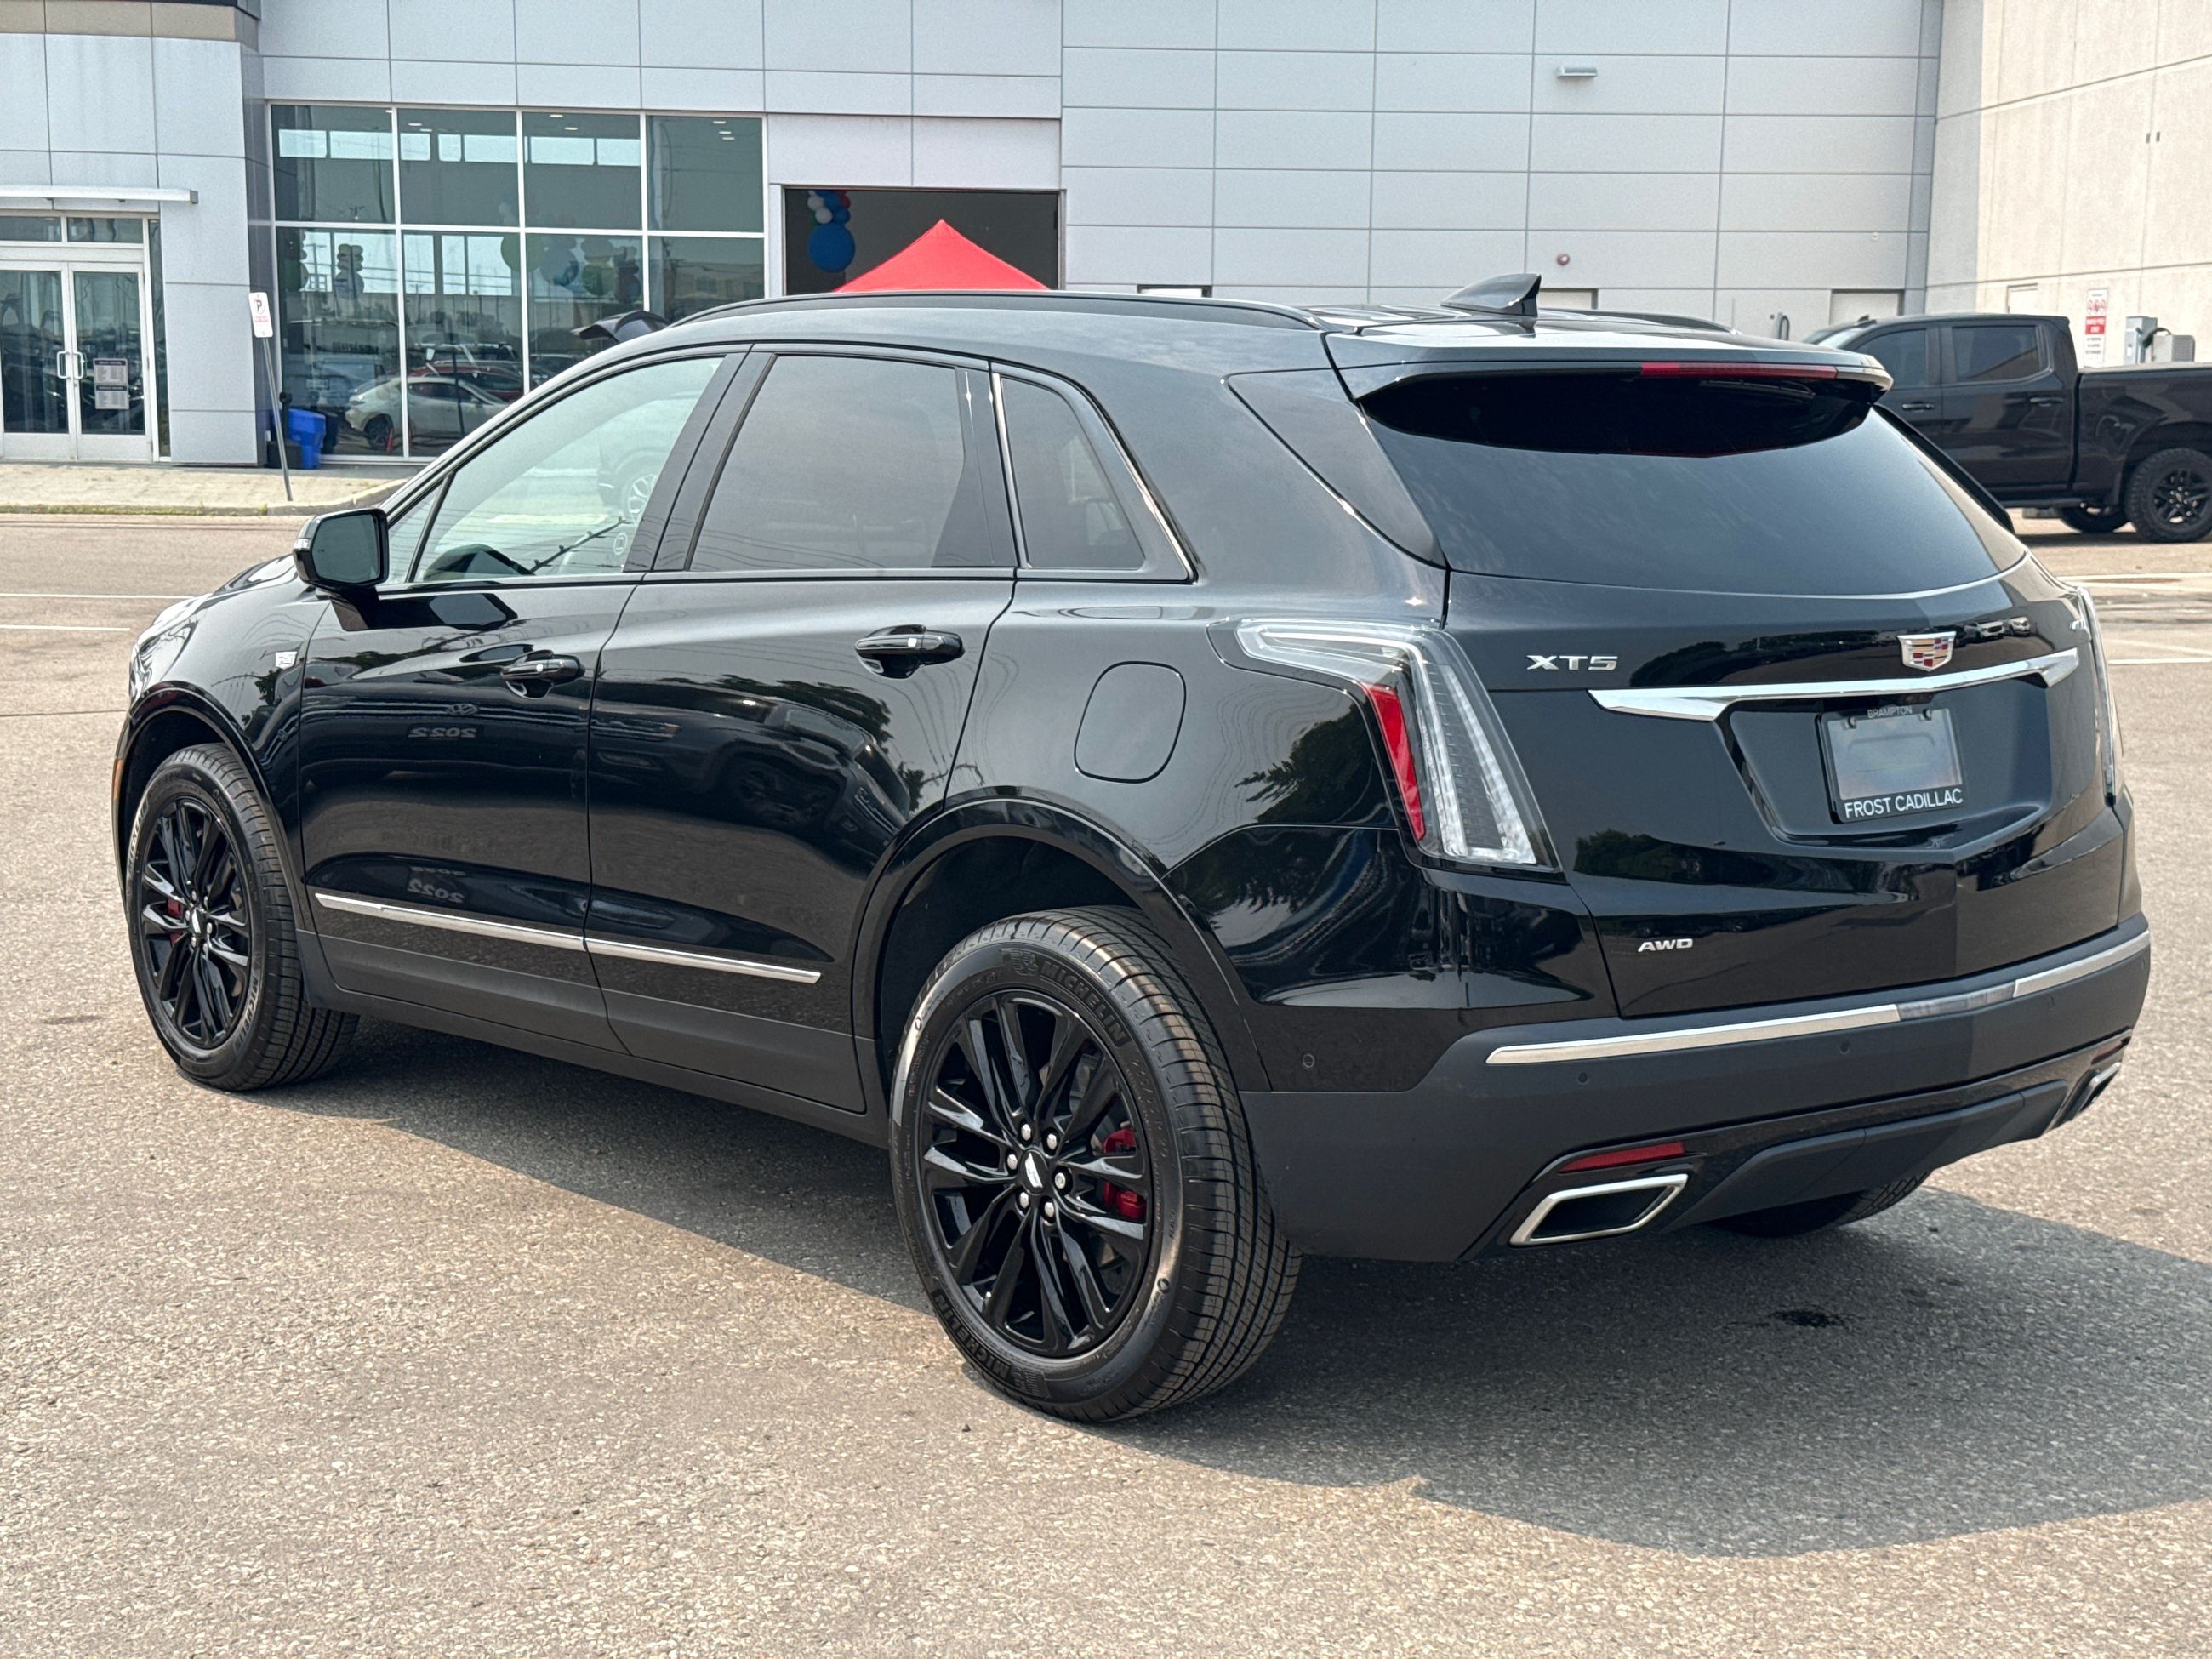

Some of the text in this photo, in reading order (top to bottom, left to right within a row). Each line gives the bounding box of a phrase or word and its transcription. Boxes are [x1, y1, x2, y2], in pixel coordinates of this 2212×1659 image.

[1526, 654, 1619, 671] XT5
[1867, 705, 1913, 719] BRAMPTON
[1844, 788, 1964, 818] FROST CADILLAC
[1638, 938, 1694, 953] AWD
[1040, 958, 1126, 1046] MICHELIN
[934, 1292, 1009, 1382] MICHELIN
